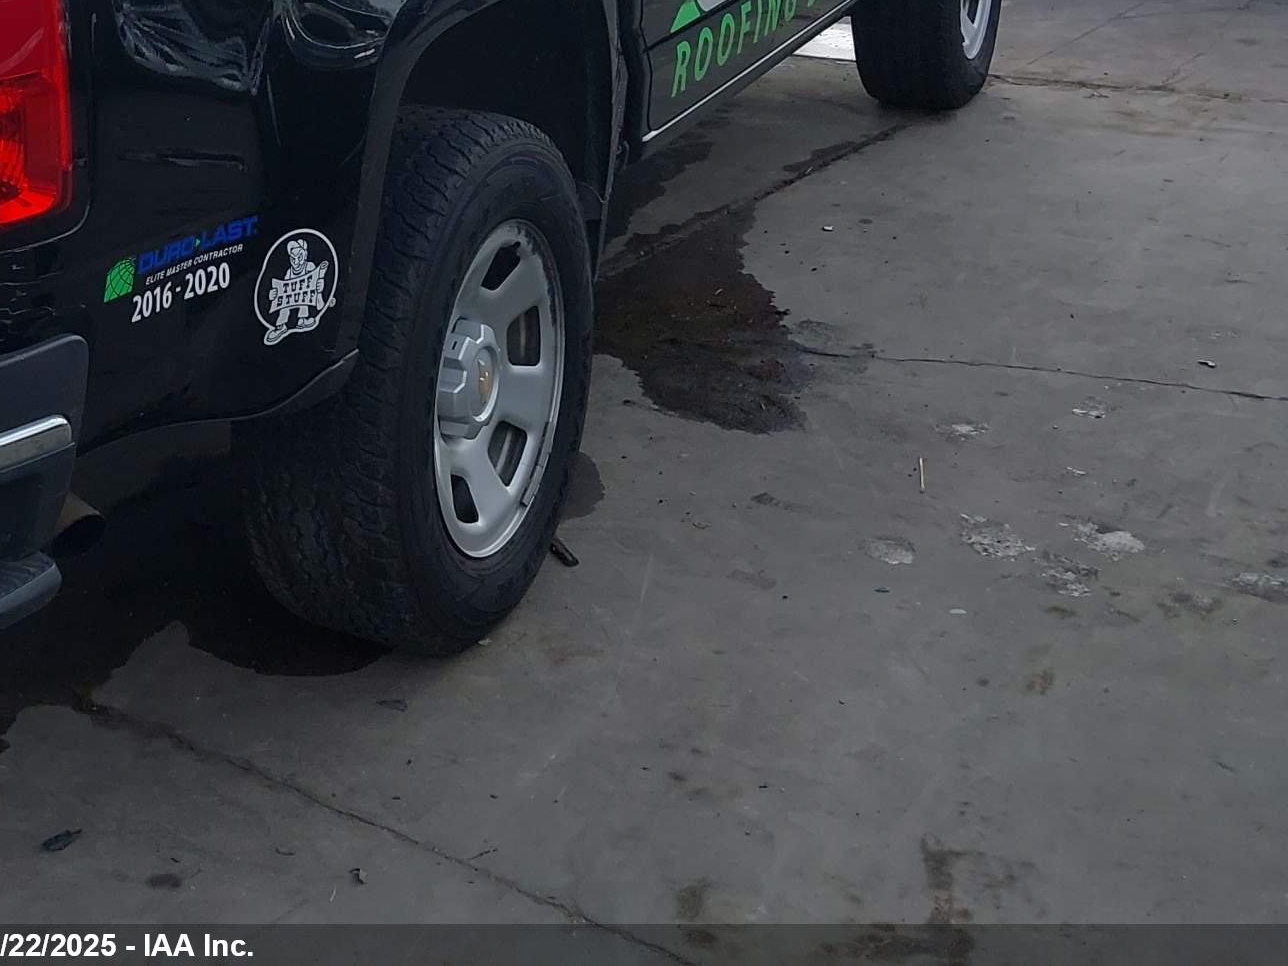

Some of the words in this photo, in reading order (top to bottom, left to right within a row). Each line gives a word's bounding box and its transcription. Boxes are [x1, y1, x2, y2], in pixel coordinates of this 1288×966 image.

[145, 270, 166, 285] ELITE
[166, 259, 193, 277] MASTER
[193, 243, 244, 265] CONTRACTOR
[131, 281, 172, 323] 2016
[183, 262, 230, 300] 2020
[276, 289, 316, 307] STUFF
[283, 276, 313, 294] TUFF
